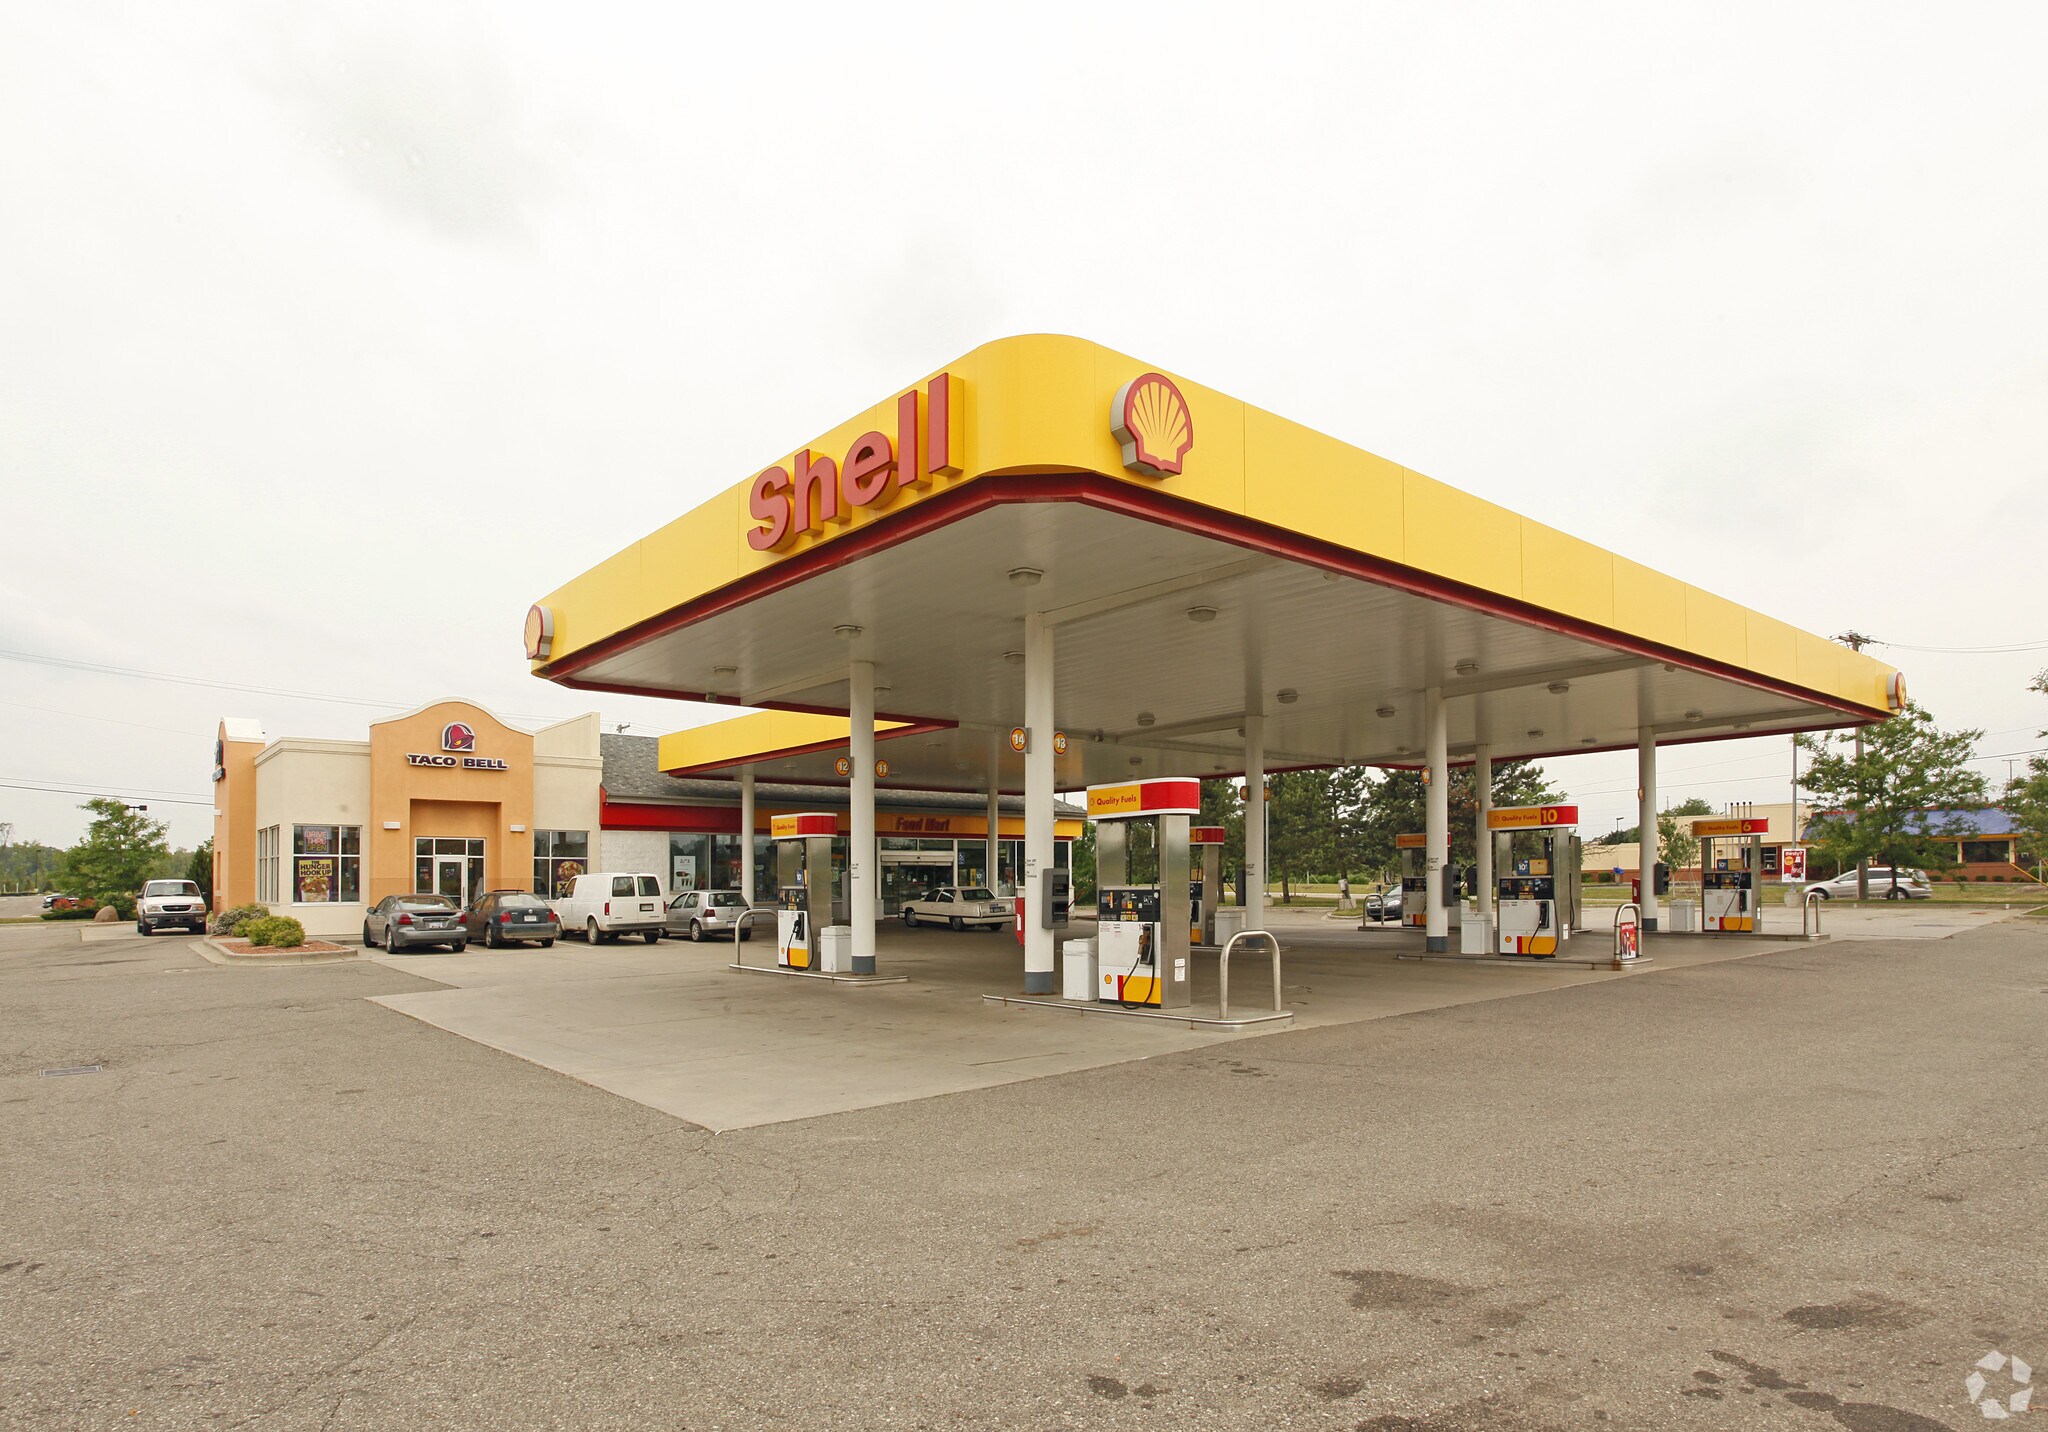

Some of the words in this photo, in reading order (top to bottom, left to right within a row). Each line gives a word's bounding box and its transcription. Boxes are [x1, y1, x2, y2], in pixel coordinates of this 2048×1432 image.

[747, 372, 948, 551] shell
[1013, 734, 1024, 745] 14
[1056, 738, 1066, 749] 13
[408, 754, 457, 766] TACO
[463, 758, 508, 769] BELL
[839, 762, 849, 771] 12
[879, 764, 887, 773] 11
[1097, 797, 1119, 806] Quality
[1121, 795, 1137, 803] Fuels
[1541, 809, 1558, 823] 10
[896, 817, 924, 831] Food
[925, 817, 951, 832] Mart
[1742, 821, 1752, 832] 6
[306, 831, 327, 839] DRIVE
[1196, 830, 1203, 841] 8
